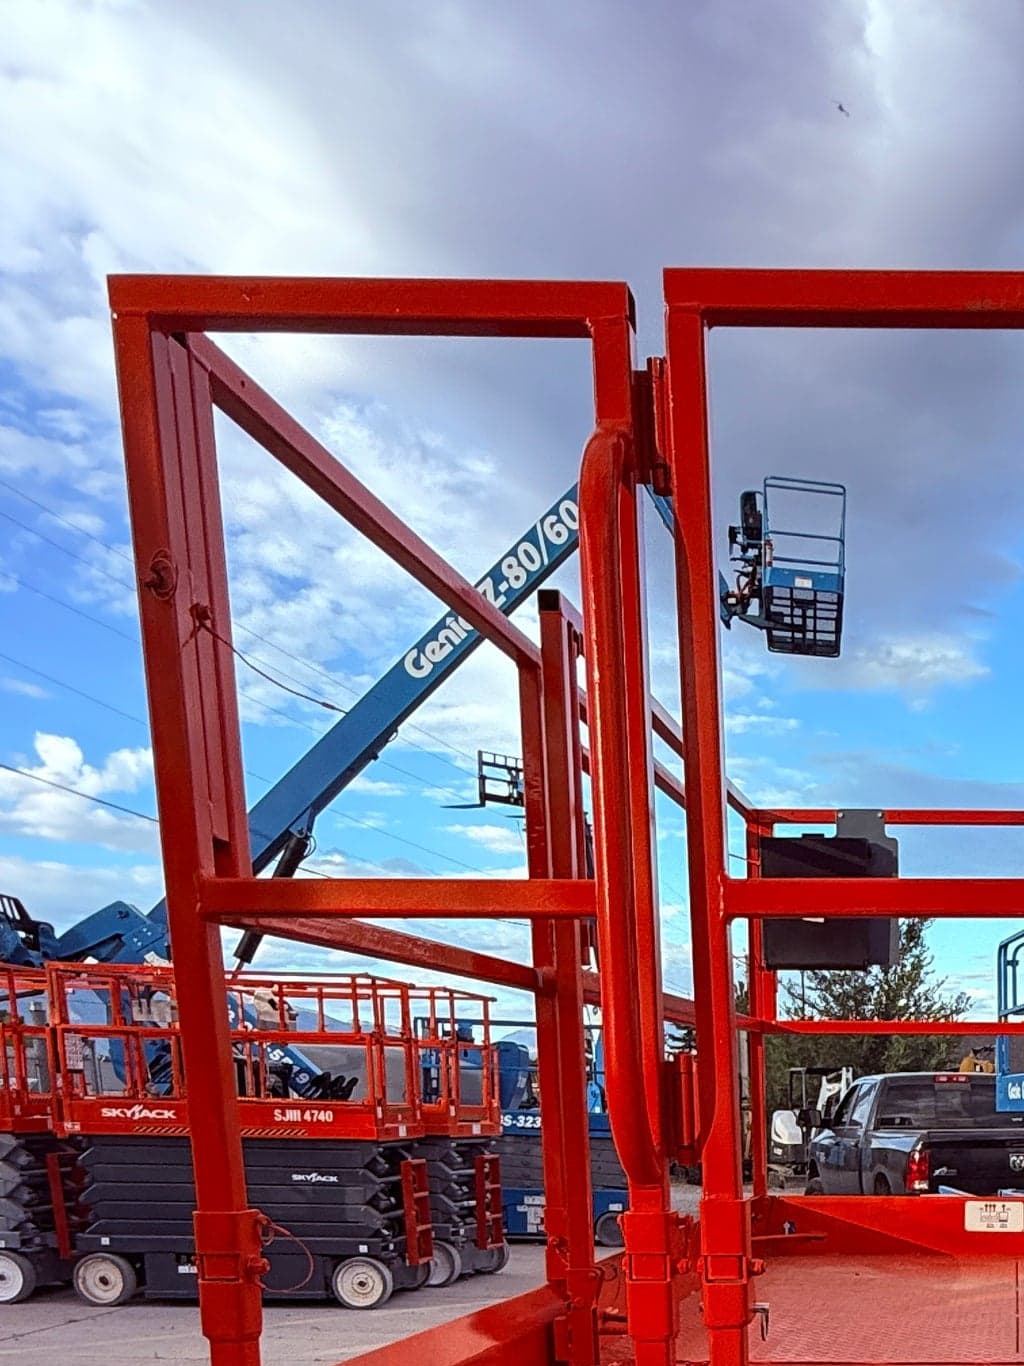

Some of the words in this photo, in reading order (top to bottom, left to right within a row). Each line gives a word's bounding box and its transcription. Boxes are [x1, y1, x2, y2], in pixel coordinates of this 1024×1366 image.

[101, 1104, 176, 1120] SKYJACK
[303, 1110, 333, 1123] 4740
[291, 1172, 339, 1183] SKYJACK
